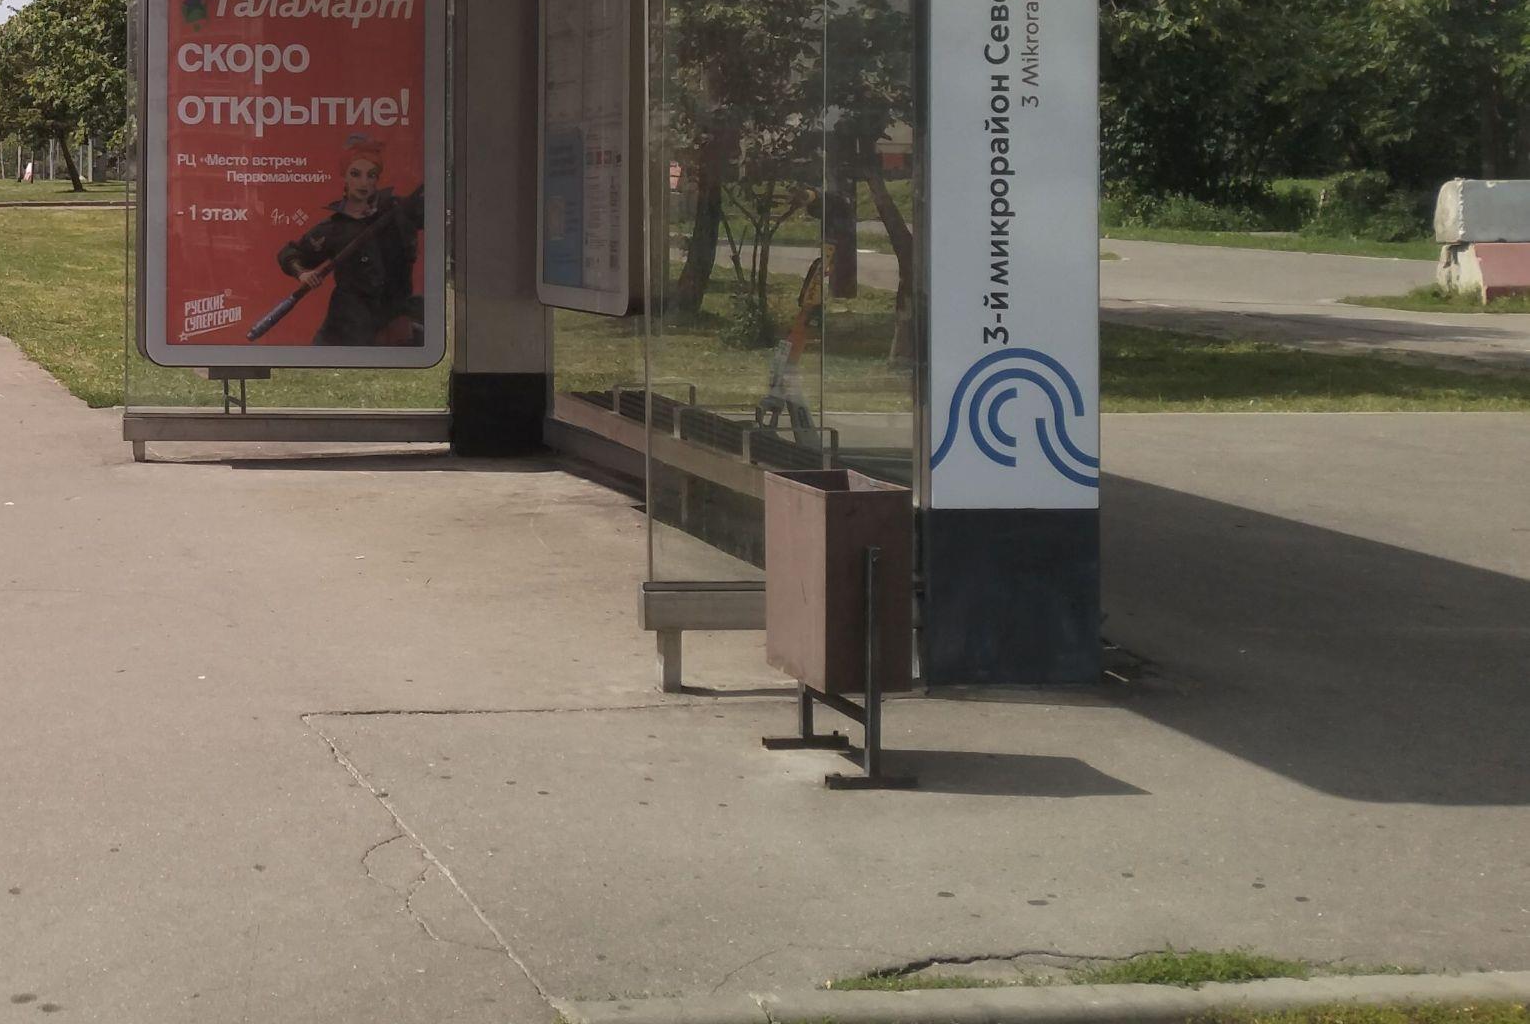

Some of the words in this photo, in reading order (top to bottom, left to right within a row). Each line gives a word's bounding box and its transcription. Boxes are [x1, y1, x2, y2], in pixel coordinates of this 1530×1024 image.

[177, 42, 310, 85] скоро
[177, 88, 410, 137] открытие!
[1022, 95, 1039, 108] 3
[177, 154, 196, 167] РЦ
[252, 156, 307, 168] встречи
[985, 74, 1015, 286] микрорайон
[202, 208, 248, 221] этаж
[184, 294, 225, 317] РУССКИЕ
